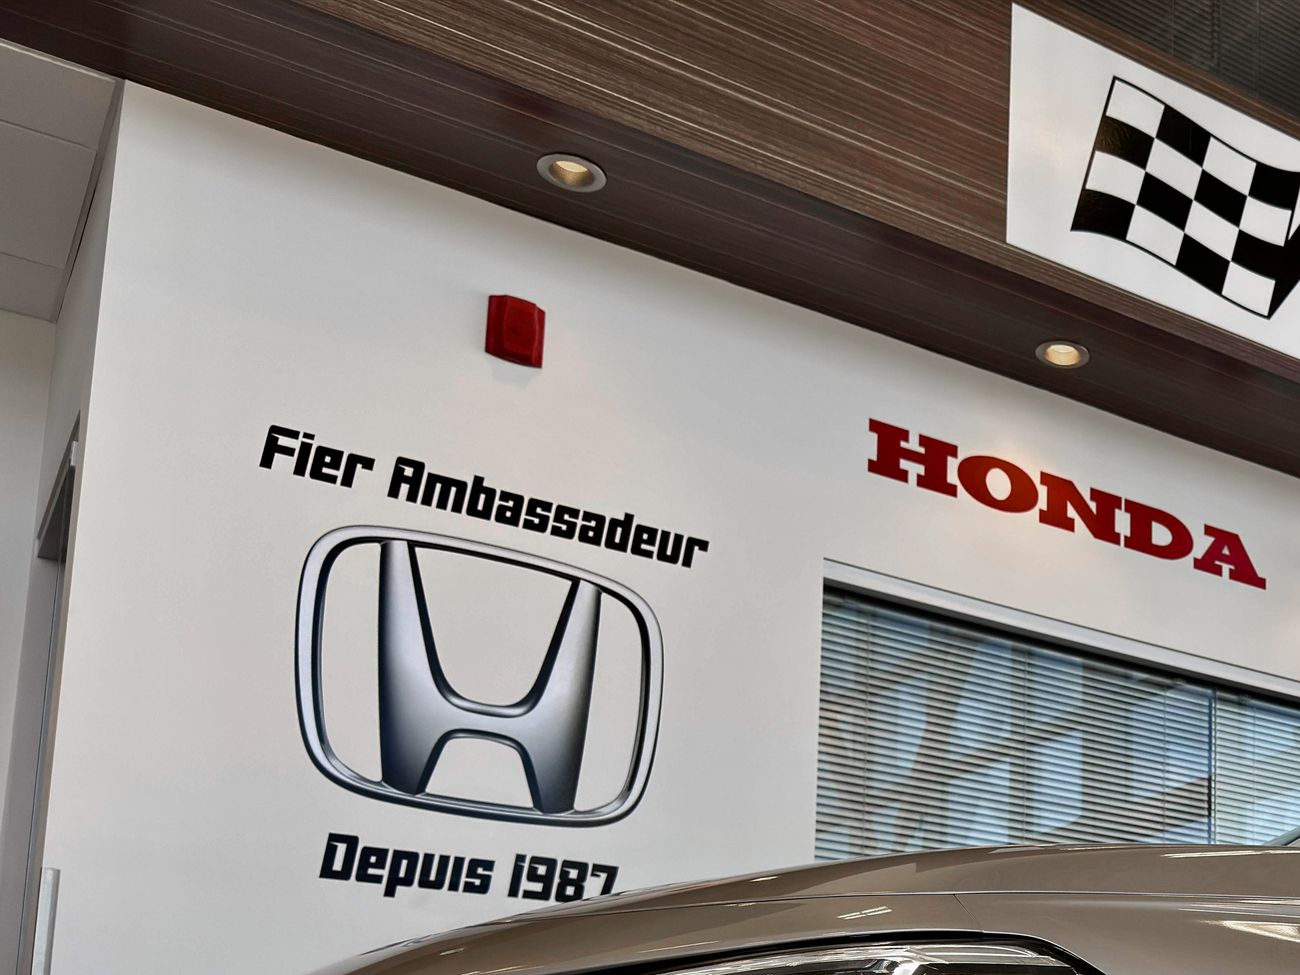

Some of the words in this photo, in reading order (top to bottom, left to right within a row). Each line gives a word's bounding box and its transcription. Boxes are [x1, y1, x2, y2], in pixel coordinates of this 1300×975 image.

[259, 424, 375, 489] Fier
[387, 456, 710, 569] Ambassadeur
[867, 418, 1267, 591] HONDA
[318, 832, 496, 898] Depuis
[507, 853, 620, 905] 1987
